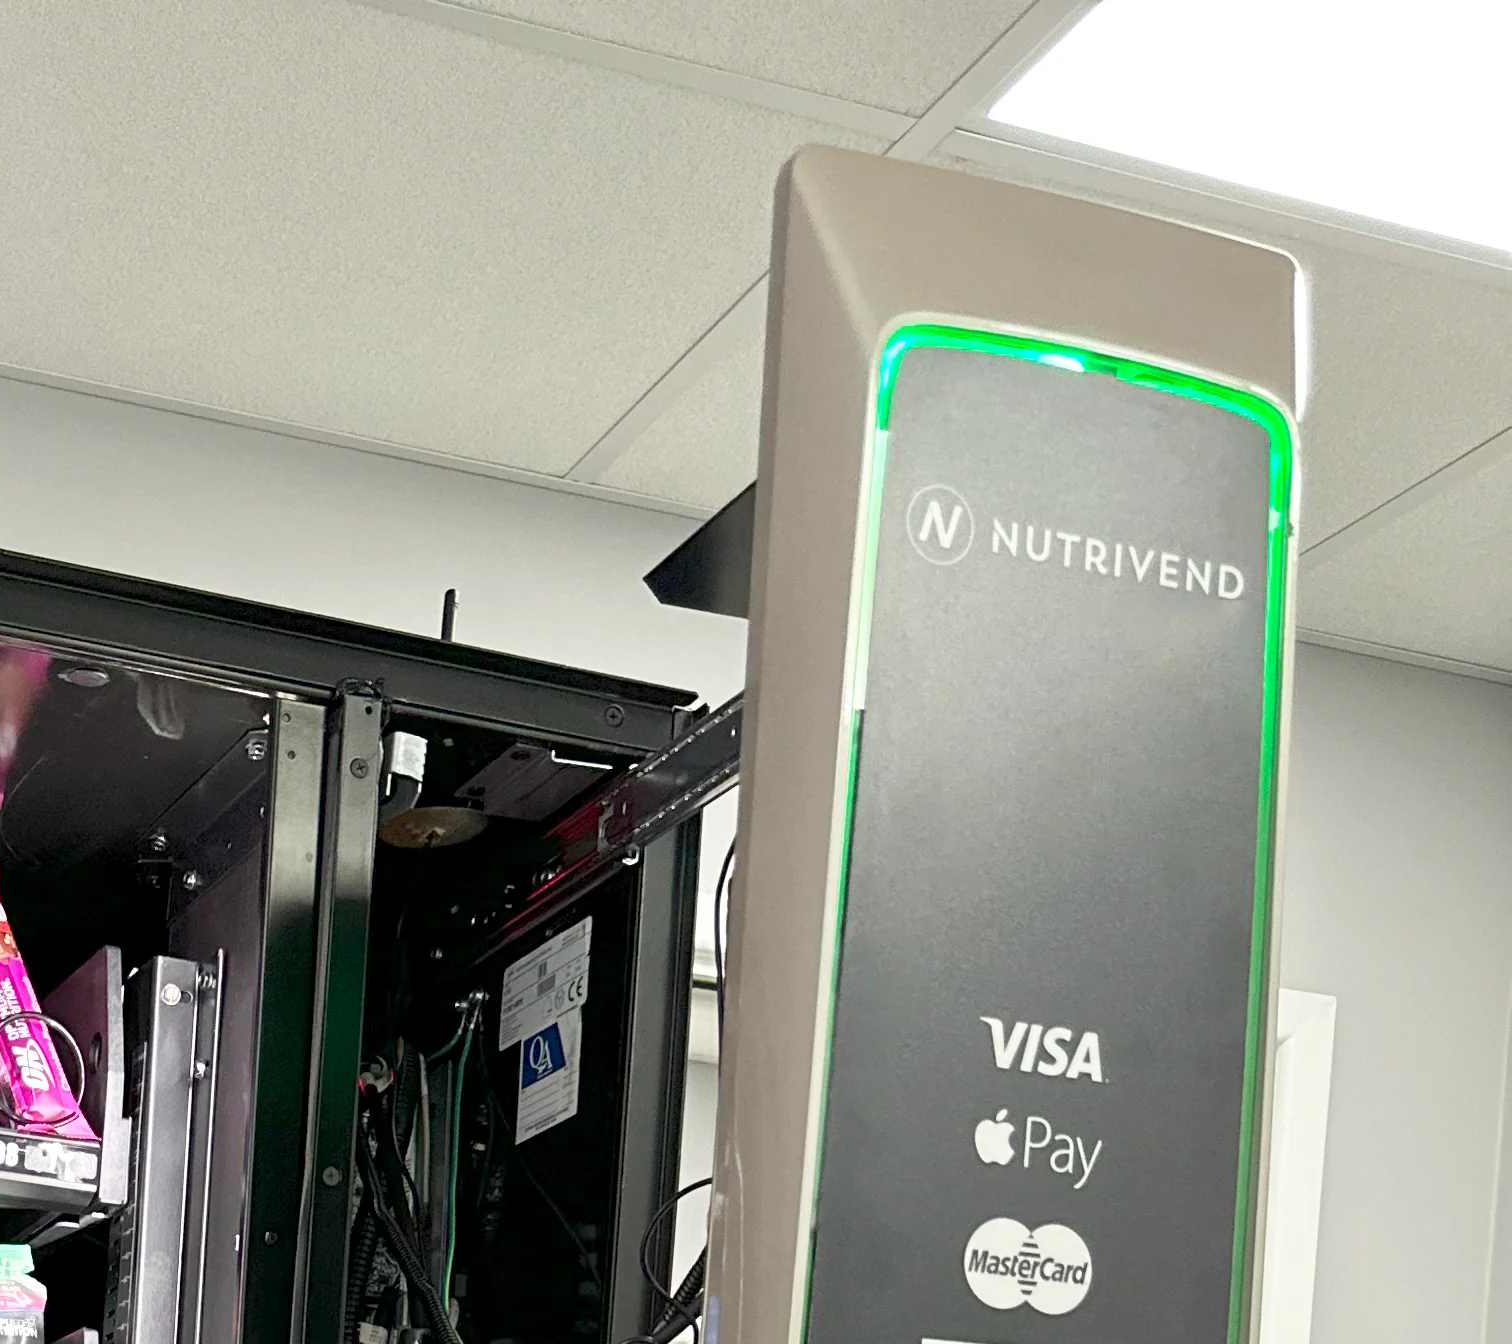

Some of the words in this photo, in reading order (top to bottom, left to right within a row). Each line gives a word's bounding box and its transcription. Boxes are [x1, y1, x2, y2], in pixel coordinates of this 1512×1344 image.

[992, 518, 1244, 600] NUTRIVEND
[979, 1015, 1103, 1083] VISA
[1024, 1116, 1102, 1189] Pay
[968, 1248, 1088, 1285] MasterCard
